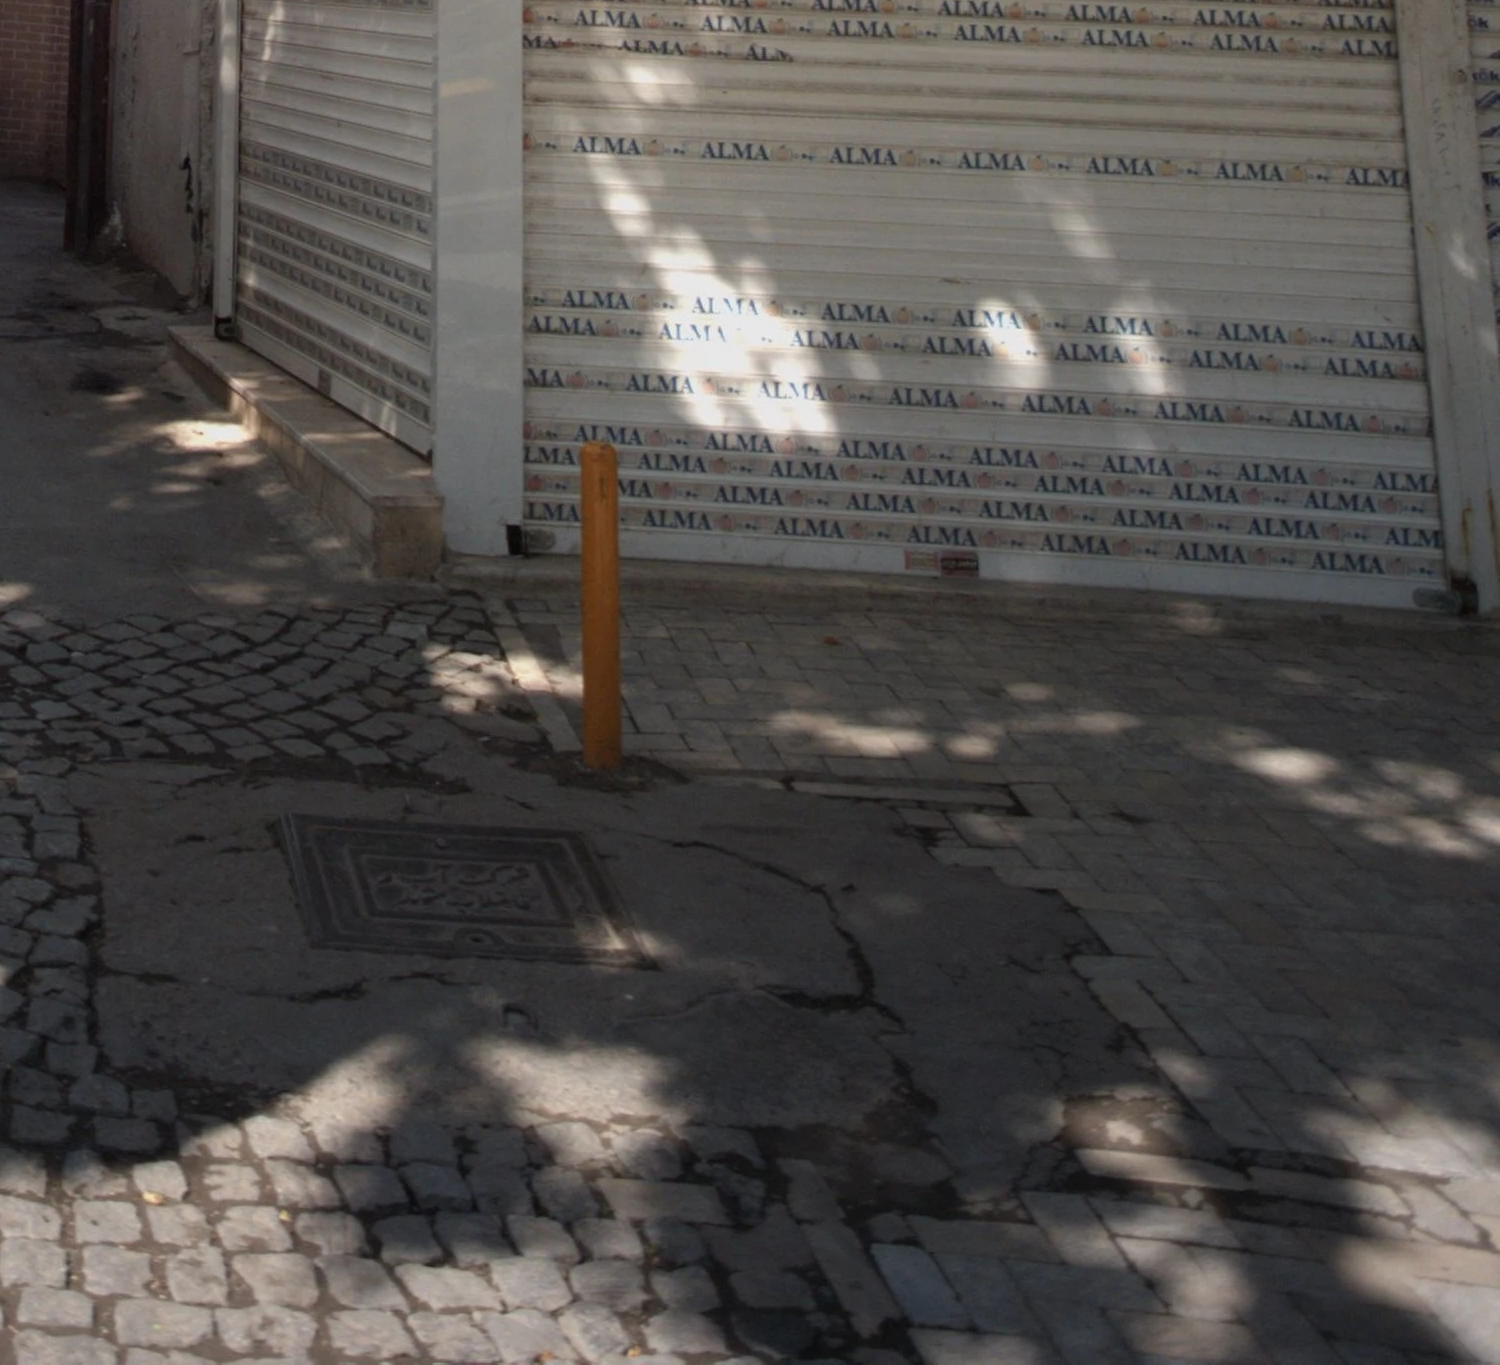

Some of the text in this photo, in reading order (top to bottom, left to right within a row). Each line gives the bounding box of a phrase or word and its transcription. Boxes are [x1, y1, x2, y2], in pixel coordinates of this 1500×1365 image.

[940, 0, 1004, 18] ALMA
[1066, 4, 1132, 23] ALMA
[1194, 9, 1260, 27] ALMA
[829, 20, 1277, 53] ALMA ALMA ALMA ALMA
[701, 142, 1154, 177] ALMA ALMA ALMA ALMA
[529, 316, 596, 335] ALMA
[562, 291, 1286, 345] ALMA ALMA ALMA
[1056, 344, 1396, 381] ALMA ALMA ALMA
[887, 388, 1360, 433] ALMA ALMA ALMA
[837, 441, 1308, 486] ALMA ALMA ALMA
[714, 485, 1320, 540] ALMA ALMA ALMA ALMA
[901, 467, 1377, 513] ALMA ALMA ALMA ALMA
[642, 510, 1247, 565] ALMA ALMA ALMA ALMA
